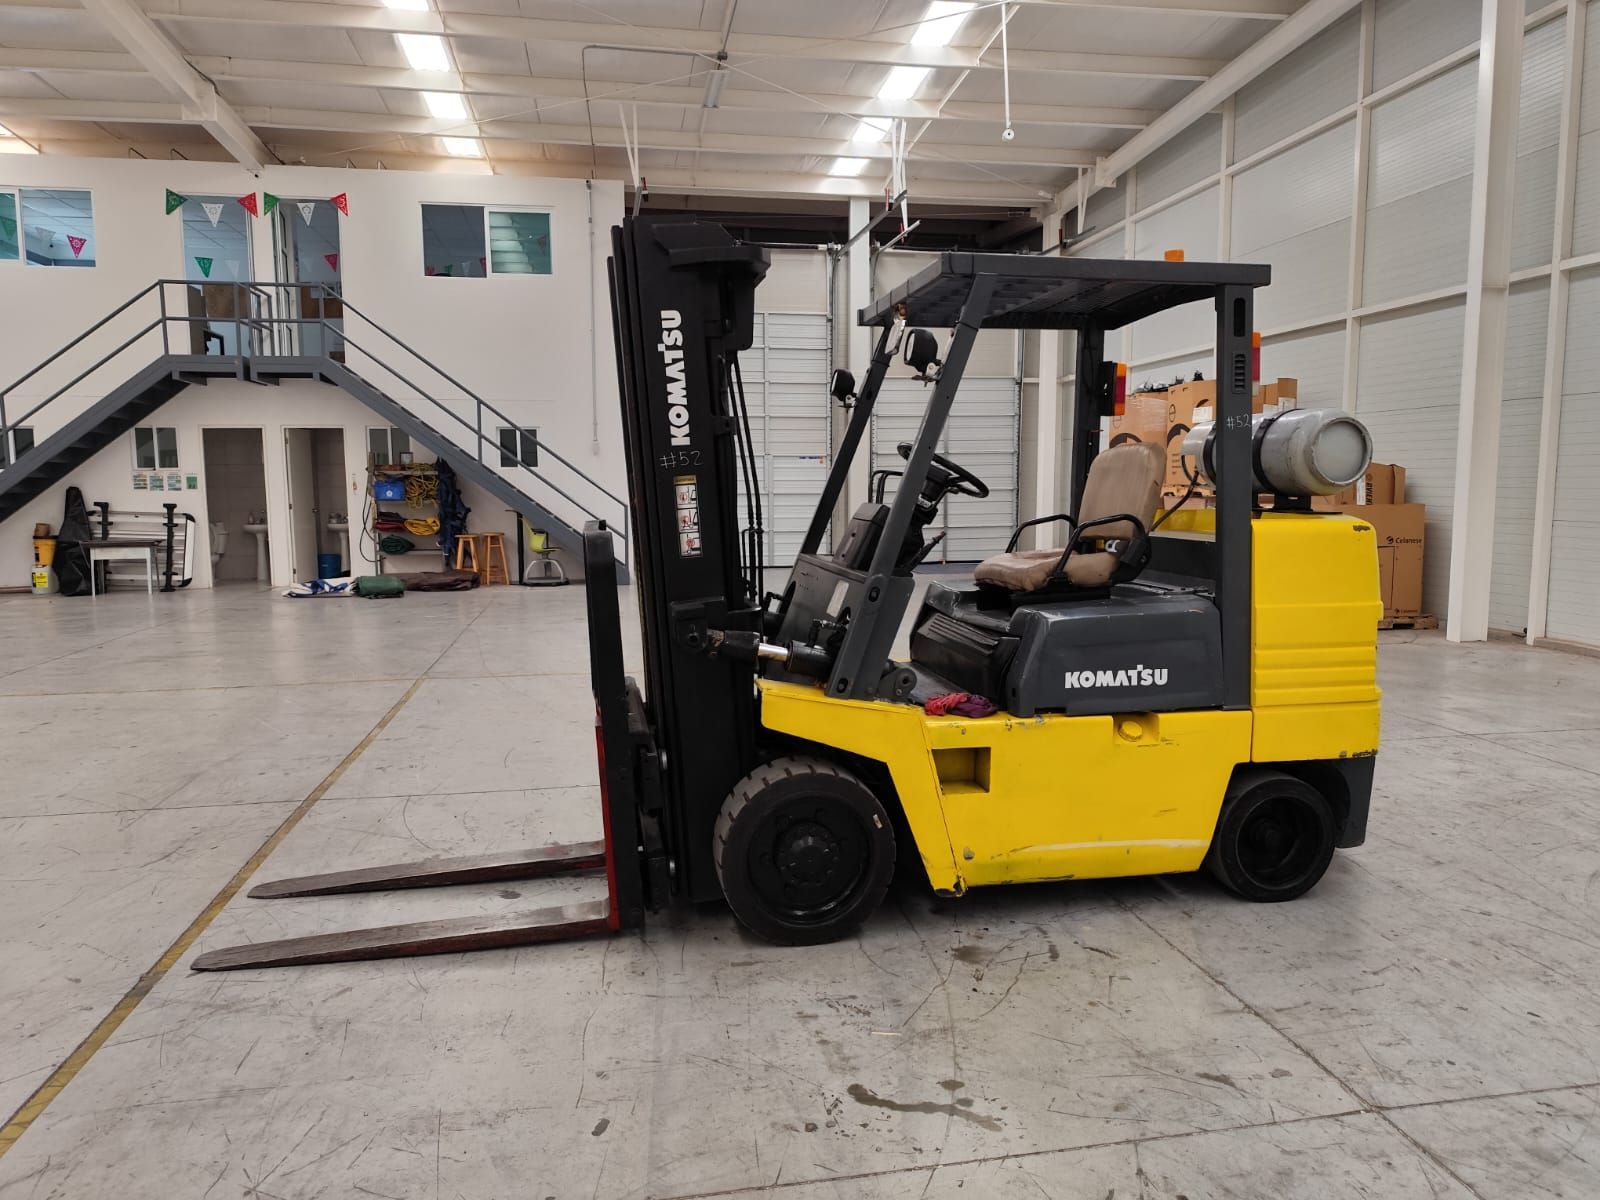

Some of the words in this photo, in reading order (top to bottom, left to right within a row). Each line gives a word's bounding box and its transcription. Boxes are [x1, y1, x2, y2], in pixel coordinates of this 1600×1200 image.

[658, 309, 691, 446] KOMATSU
[1226, 413, 1252, 430] #52
[659, 450, 703, 469] #52
[1064, 664, 1169, 689] KOMATSU
